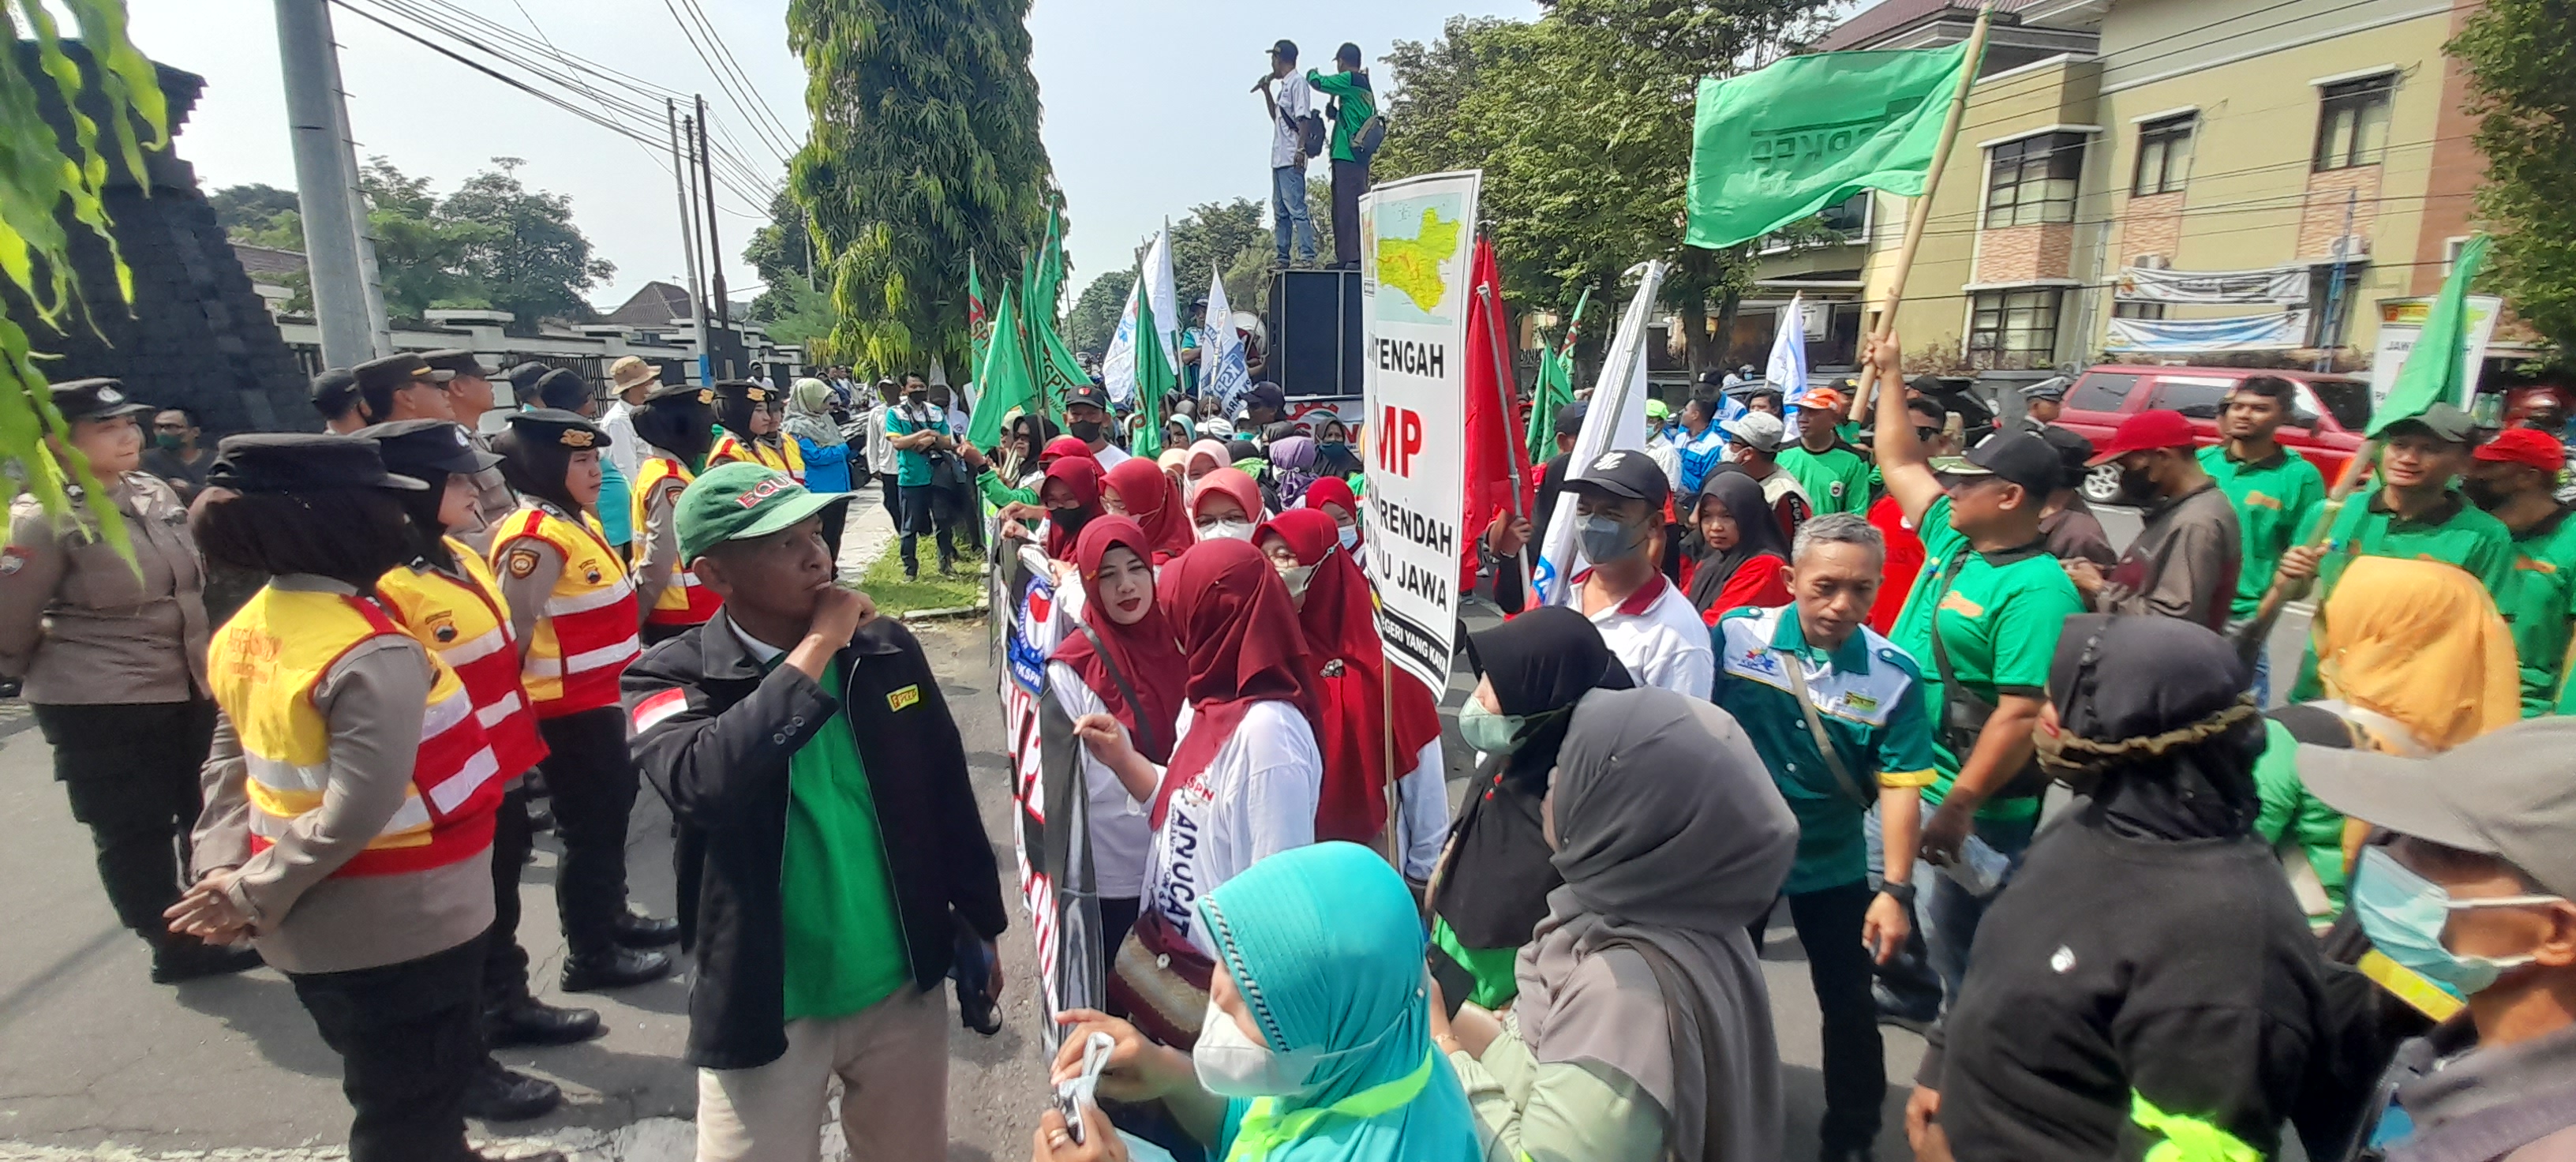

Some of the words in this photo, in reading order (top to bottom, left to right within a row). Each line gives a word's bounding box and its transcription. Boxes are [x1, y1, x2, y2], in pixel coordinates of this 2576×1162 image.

[1380, 498, 1452, 558] RENDAH
[1397, 560, 1447, 613] JAWA
[1405, 629, 1428, 658] YANG
[1429, 646, 1447, 675] KAYA
